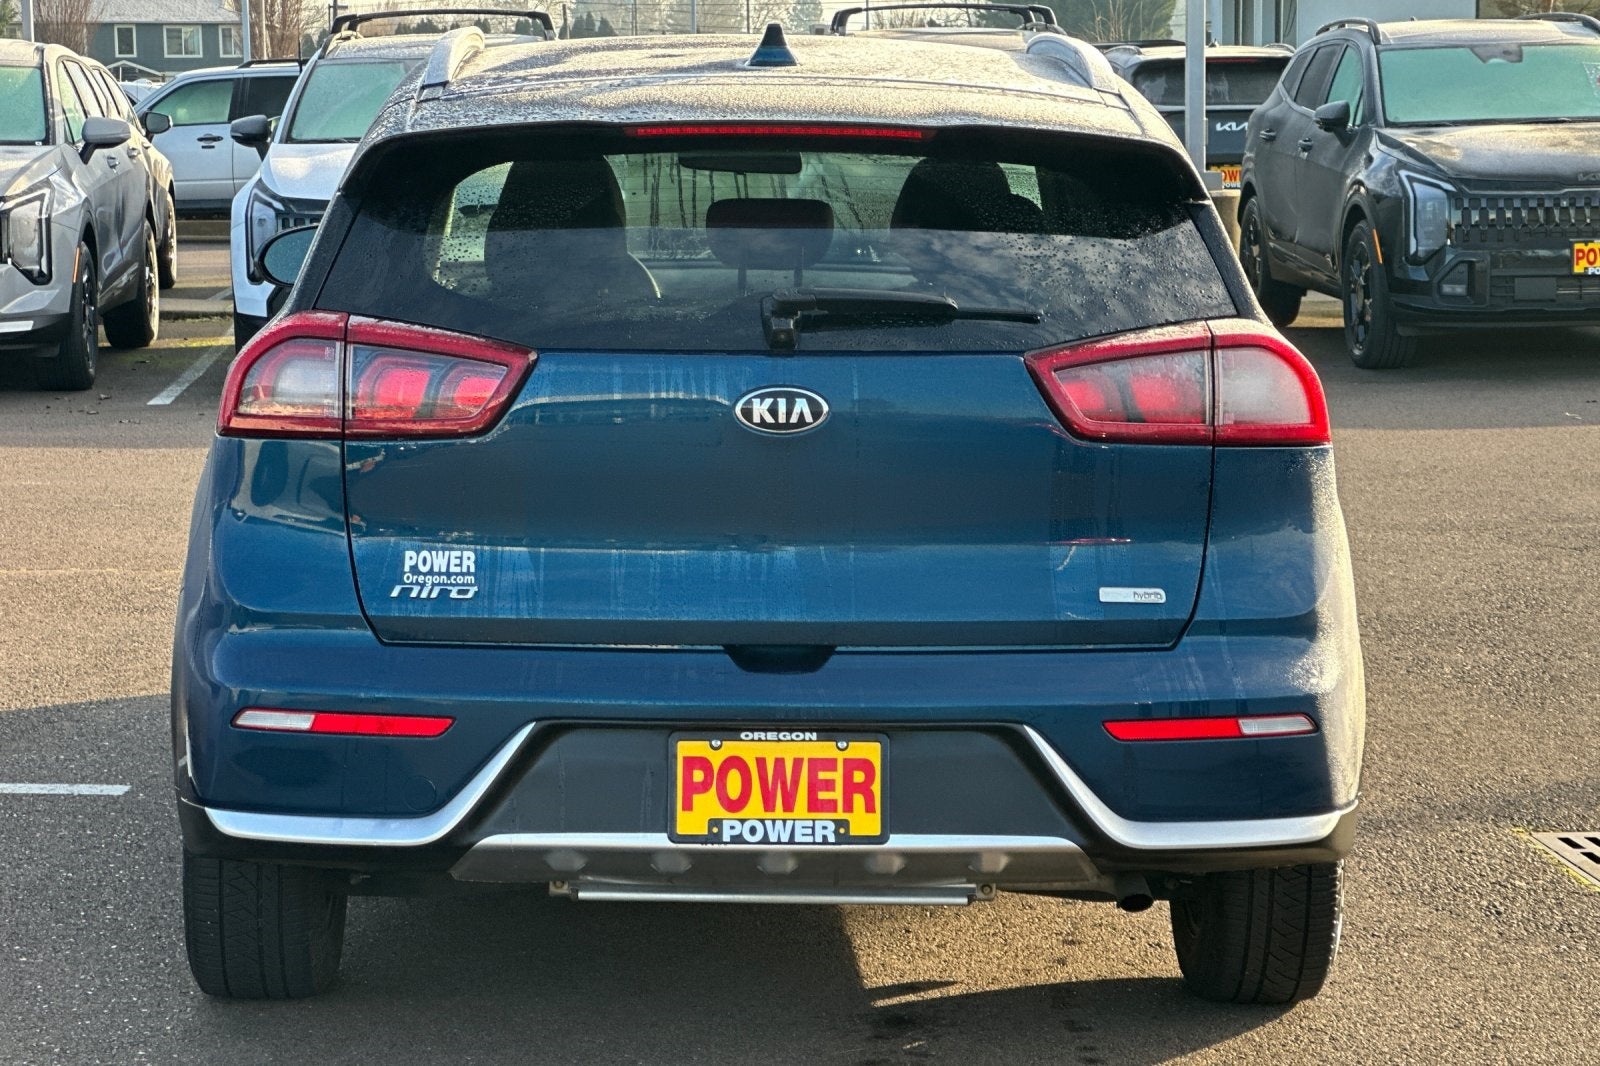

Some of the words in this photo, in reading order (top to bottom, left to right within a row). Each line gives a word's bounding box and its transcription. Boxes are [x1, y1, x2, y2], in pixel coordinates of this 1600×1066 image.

[752, 398, 813, 423] KIA
[404, 550, 476, 573] POWER
[404, 573, 475, 586] Oregon.com
[390, 585, 478, 598] niro
[740, 732, 817, 741] OREGON
[682, 755, 876, 813] POWER
[722, 820, 836, 843] POWER
